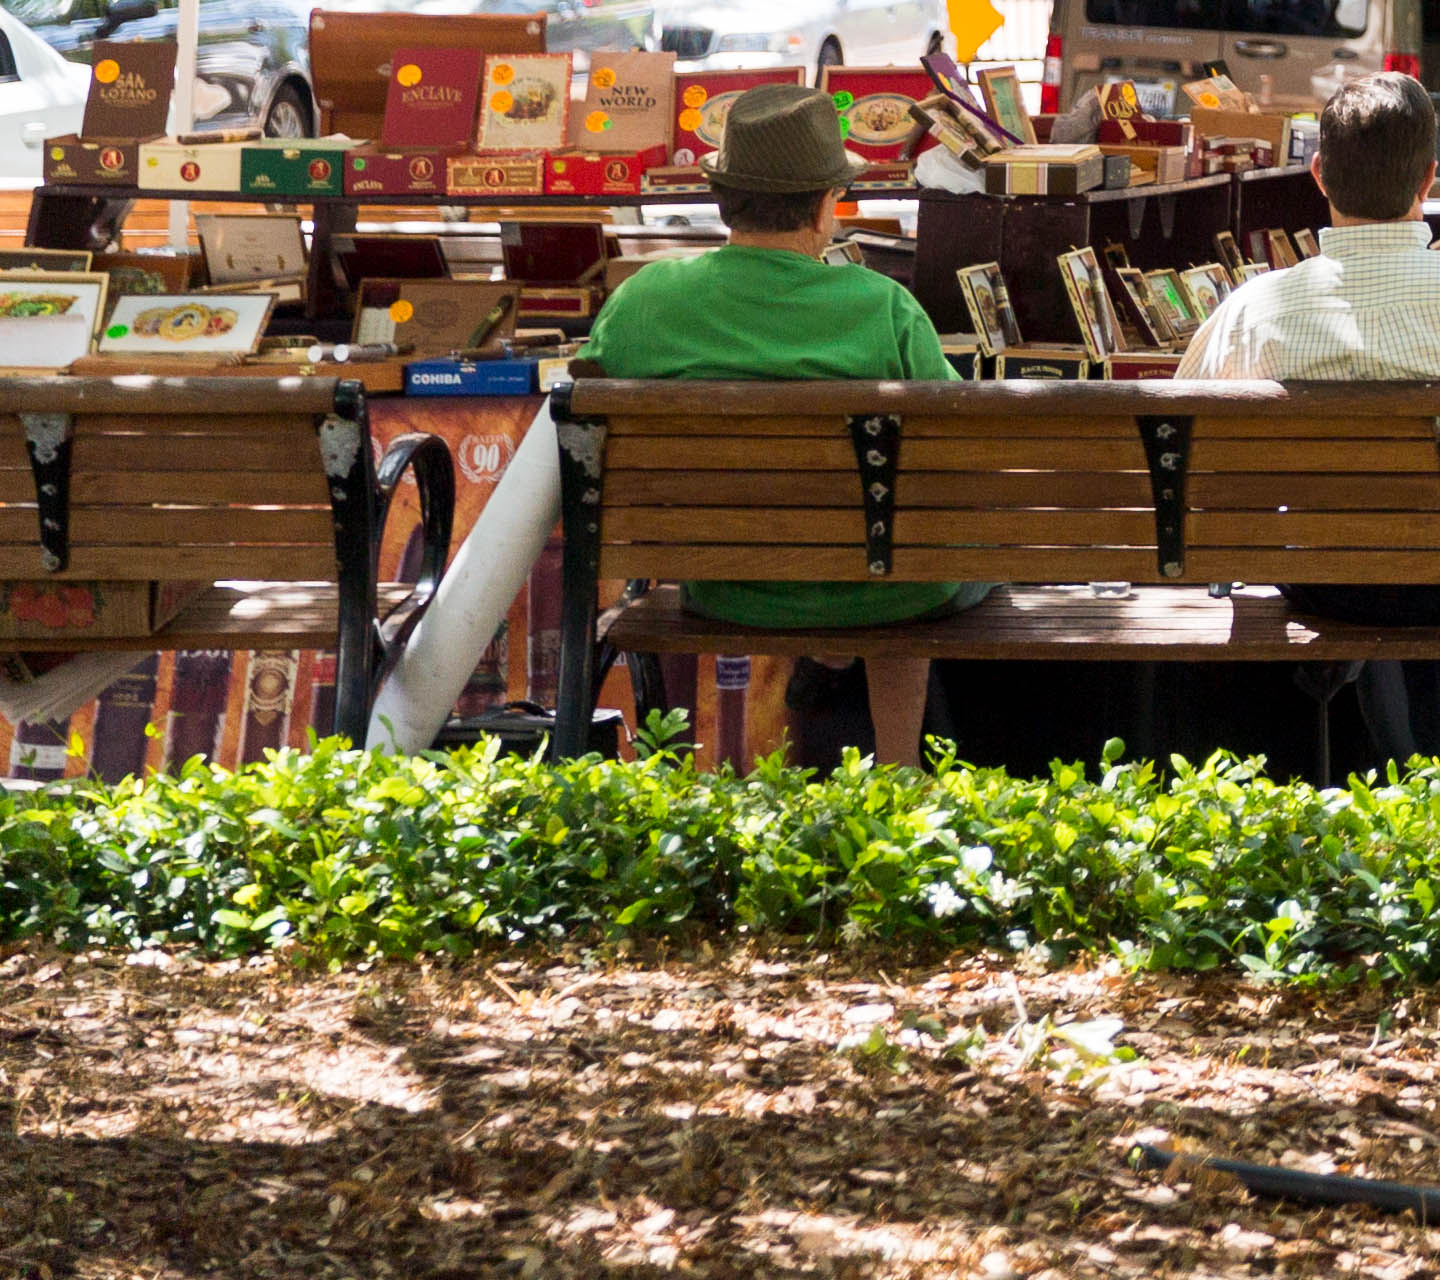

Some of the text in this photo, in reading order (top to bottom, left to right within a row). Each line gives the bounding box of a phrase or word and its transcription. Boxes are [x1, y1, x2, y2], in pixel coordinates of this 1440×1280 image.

[401, 86, 463, 103] ENCLAVE
[611, 85, 649, 97] NEW
[600, 96, 657, 109] WORLD
[411, 372, 463, 385] COHIBA
[473, 443, 500, 474] 90
